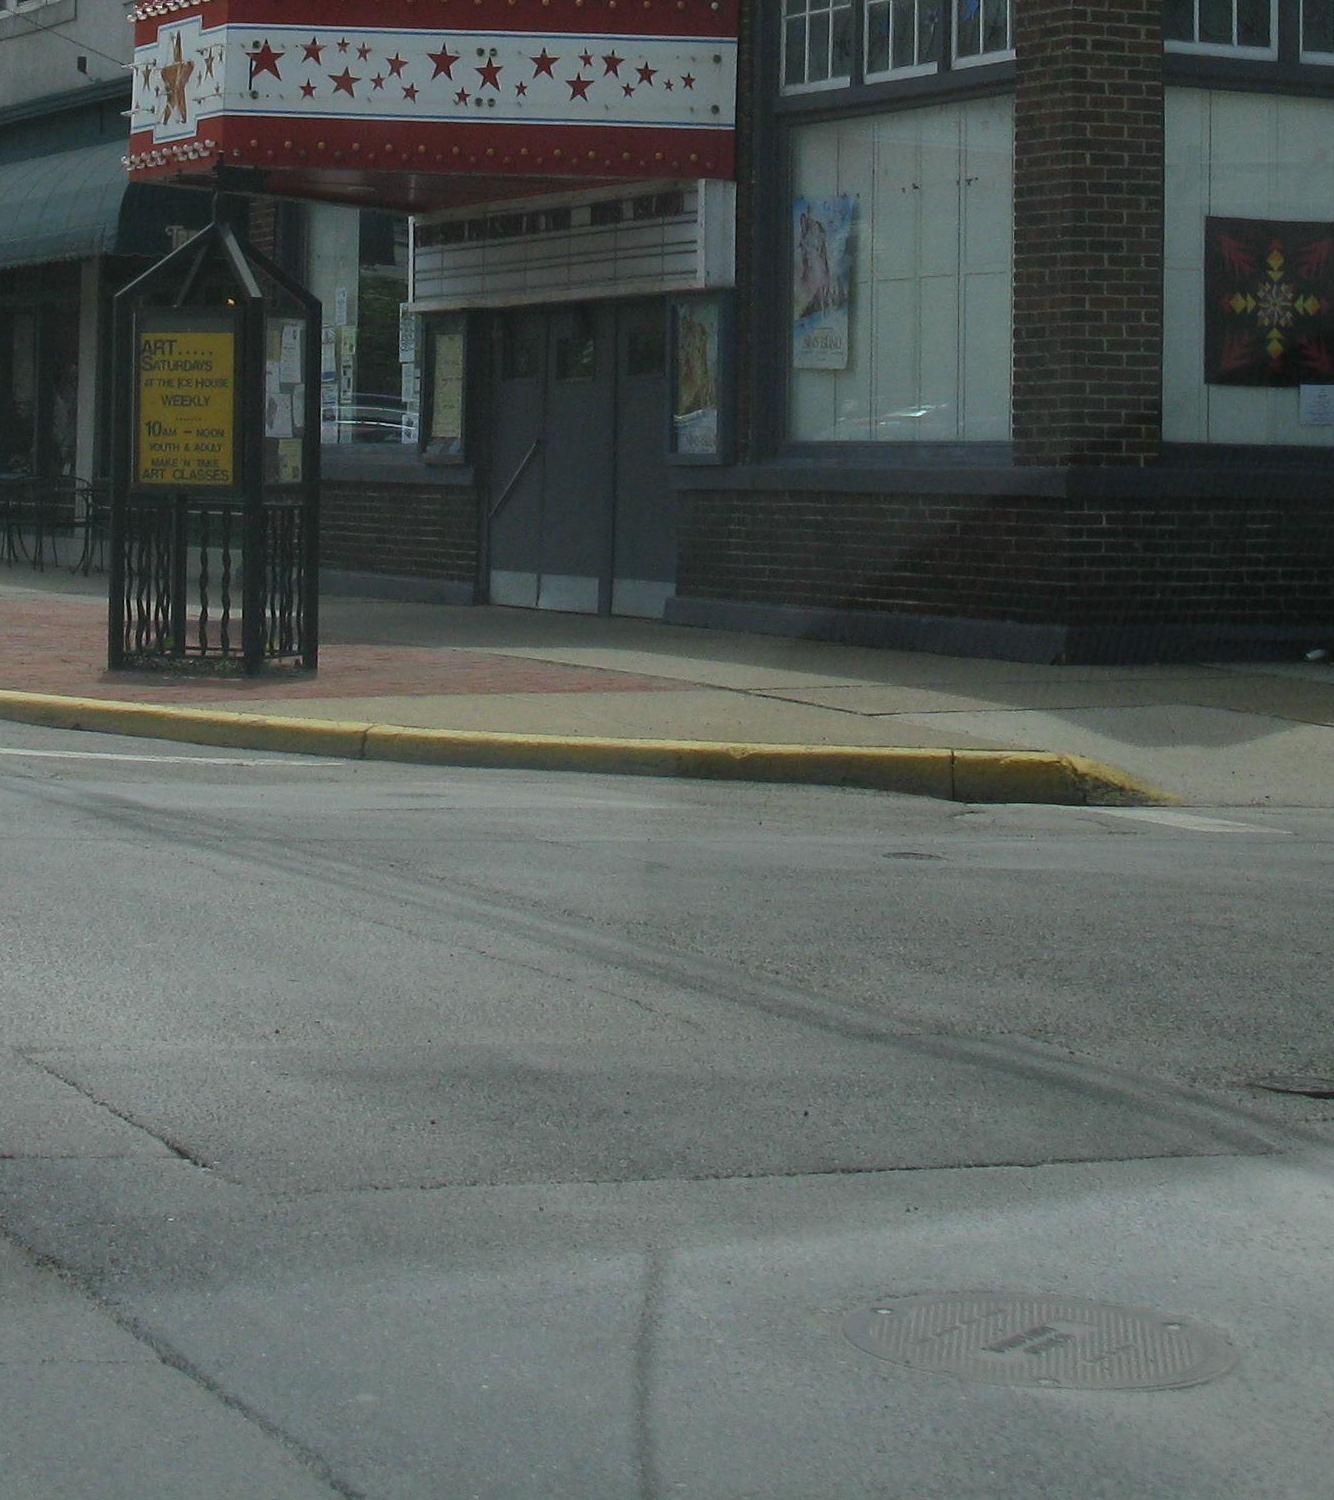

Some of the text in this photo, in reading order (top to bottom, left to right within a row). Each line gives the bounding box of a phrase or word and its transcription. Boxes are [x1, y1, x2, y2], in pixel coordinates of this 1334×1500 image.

[144, 378, 228, 389] AT THE ICE HOUSE
[161, 395, 211, 407] WEEKLY
[196, 428, 225, 438] NOON
[149, 443, 222, 453] YOUTH & ADULT
[151, 458, 178, 468] MAKE
[197, 458, 219, 468] TAKE
[142, 468, 229, 482] ART CLASSES
